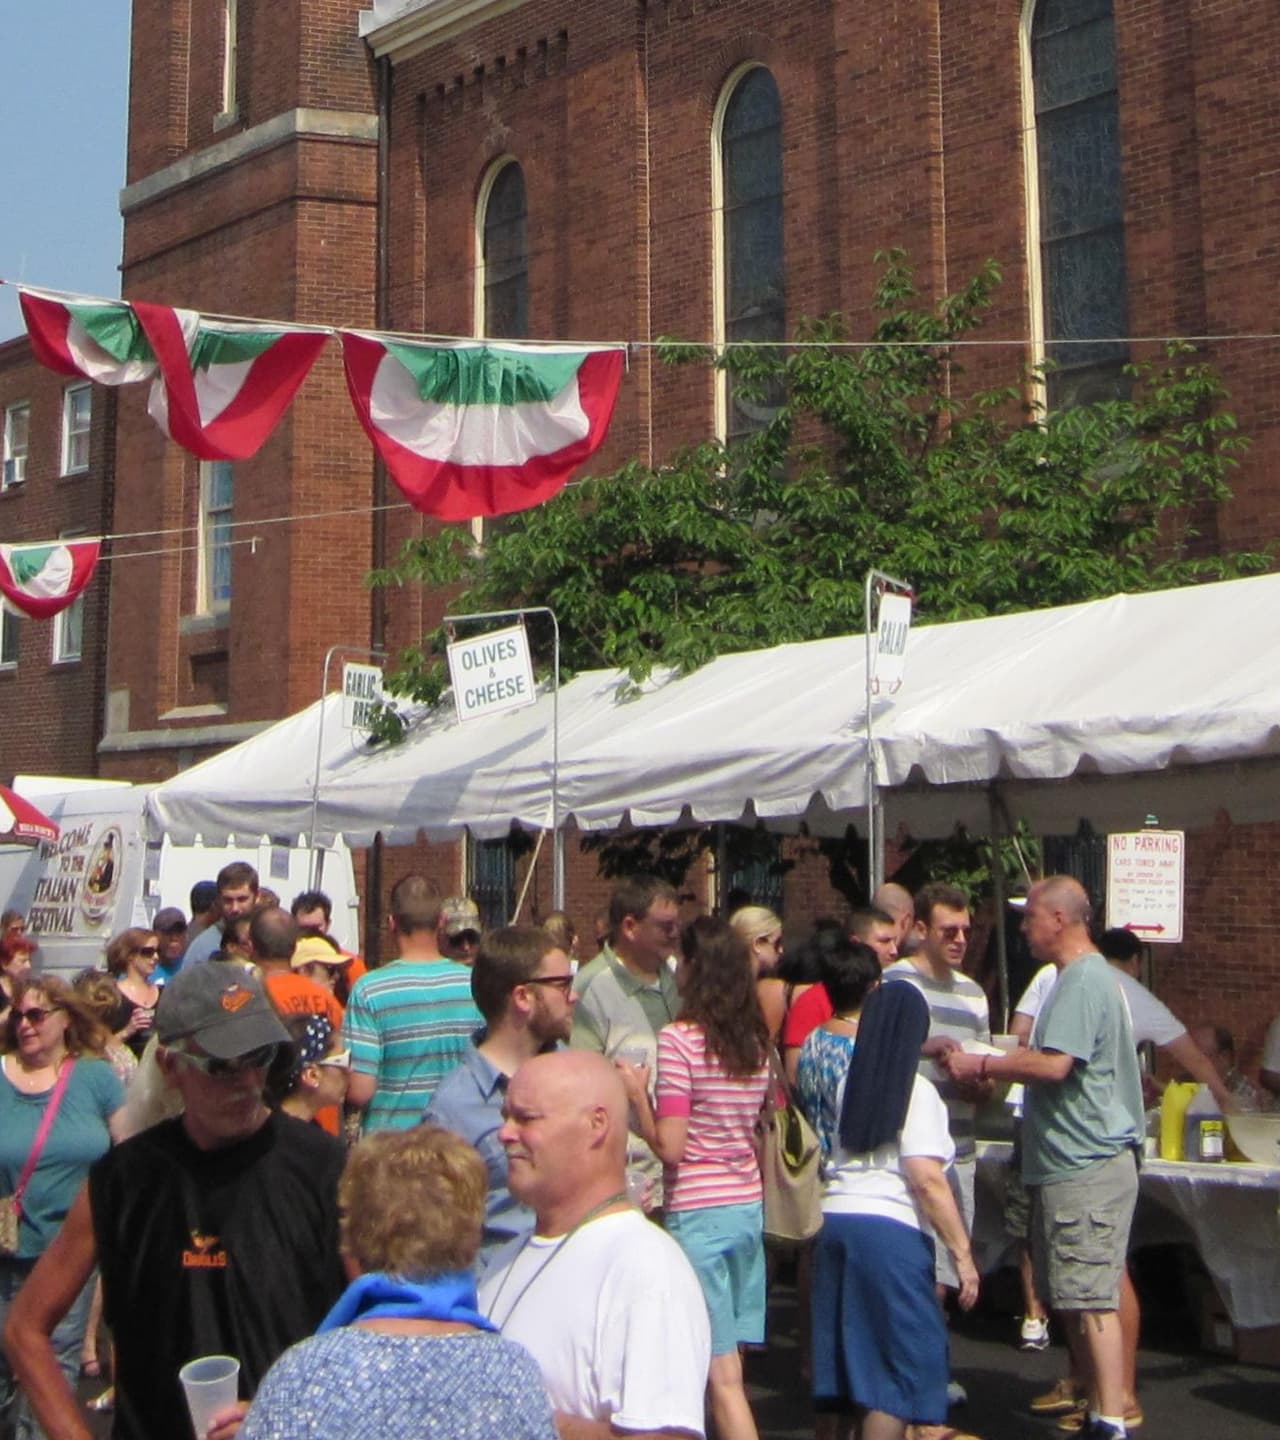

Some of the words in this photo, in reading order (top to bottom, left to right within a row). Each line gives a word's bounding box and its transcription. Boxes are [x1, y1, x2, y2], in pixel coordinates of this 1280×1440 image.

[878, 620, 908, 657] SALAD
[461, 638, 517, 671] OLIVES
[345, 670, 377, 700] GARLIC
[488, 666, 496, 678] &
[464, 674, 526, 709] CHEESE
[40, 822, 95, 860] WELCOME
[1113, 836, 1127, 851] NO
[1134, 836, 1179, 854] PARKING
[61, 855, 71, 872] TO
[72, 855, 86, 872] THE
[33, 878, 80, 903] ITALIAN
[26, 907, 75, 933] FESTIVAL
